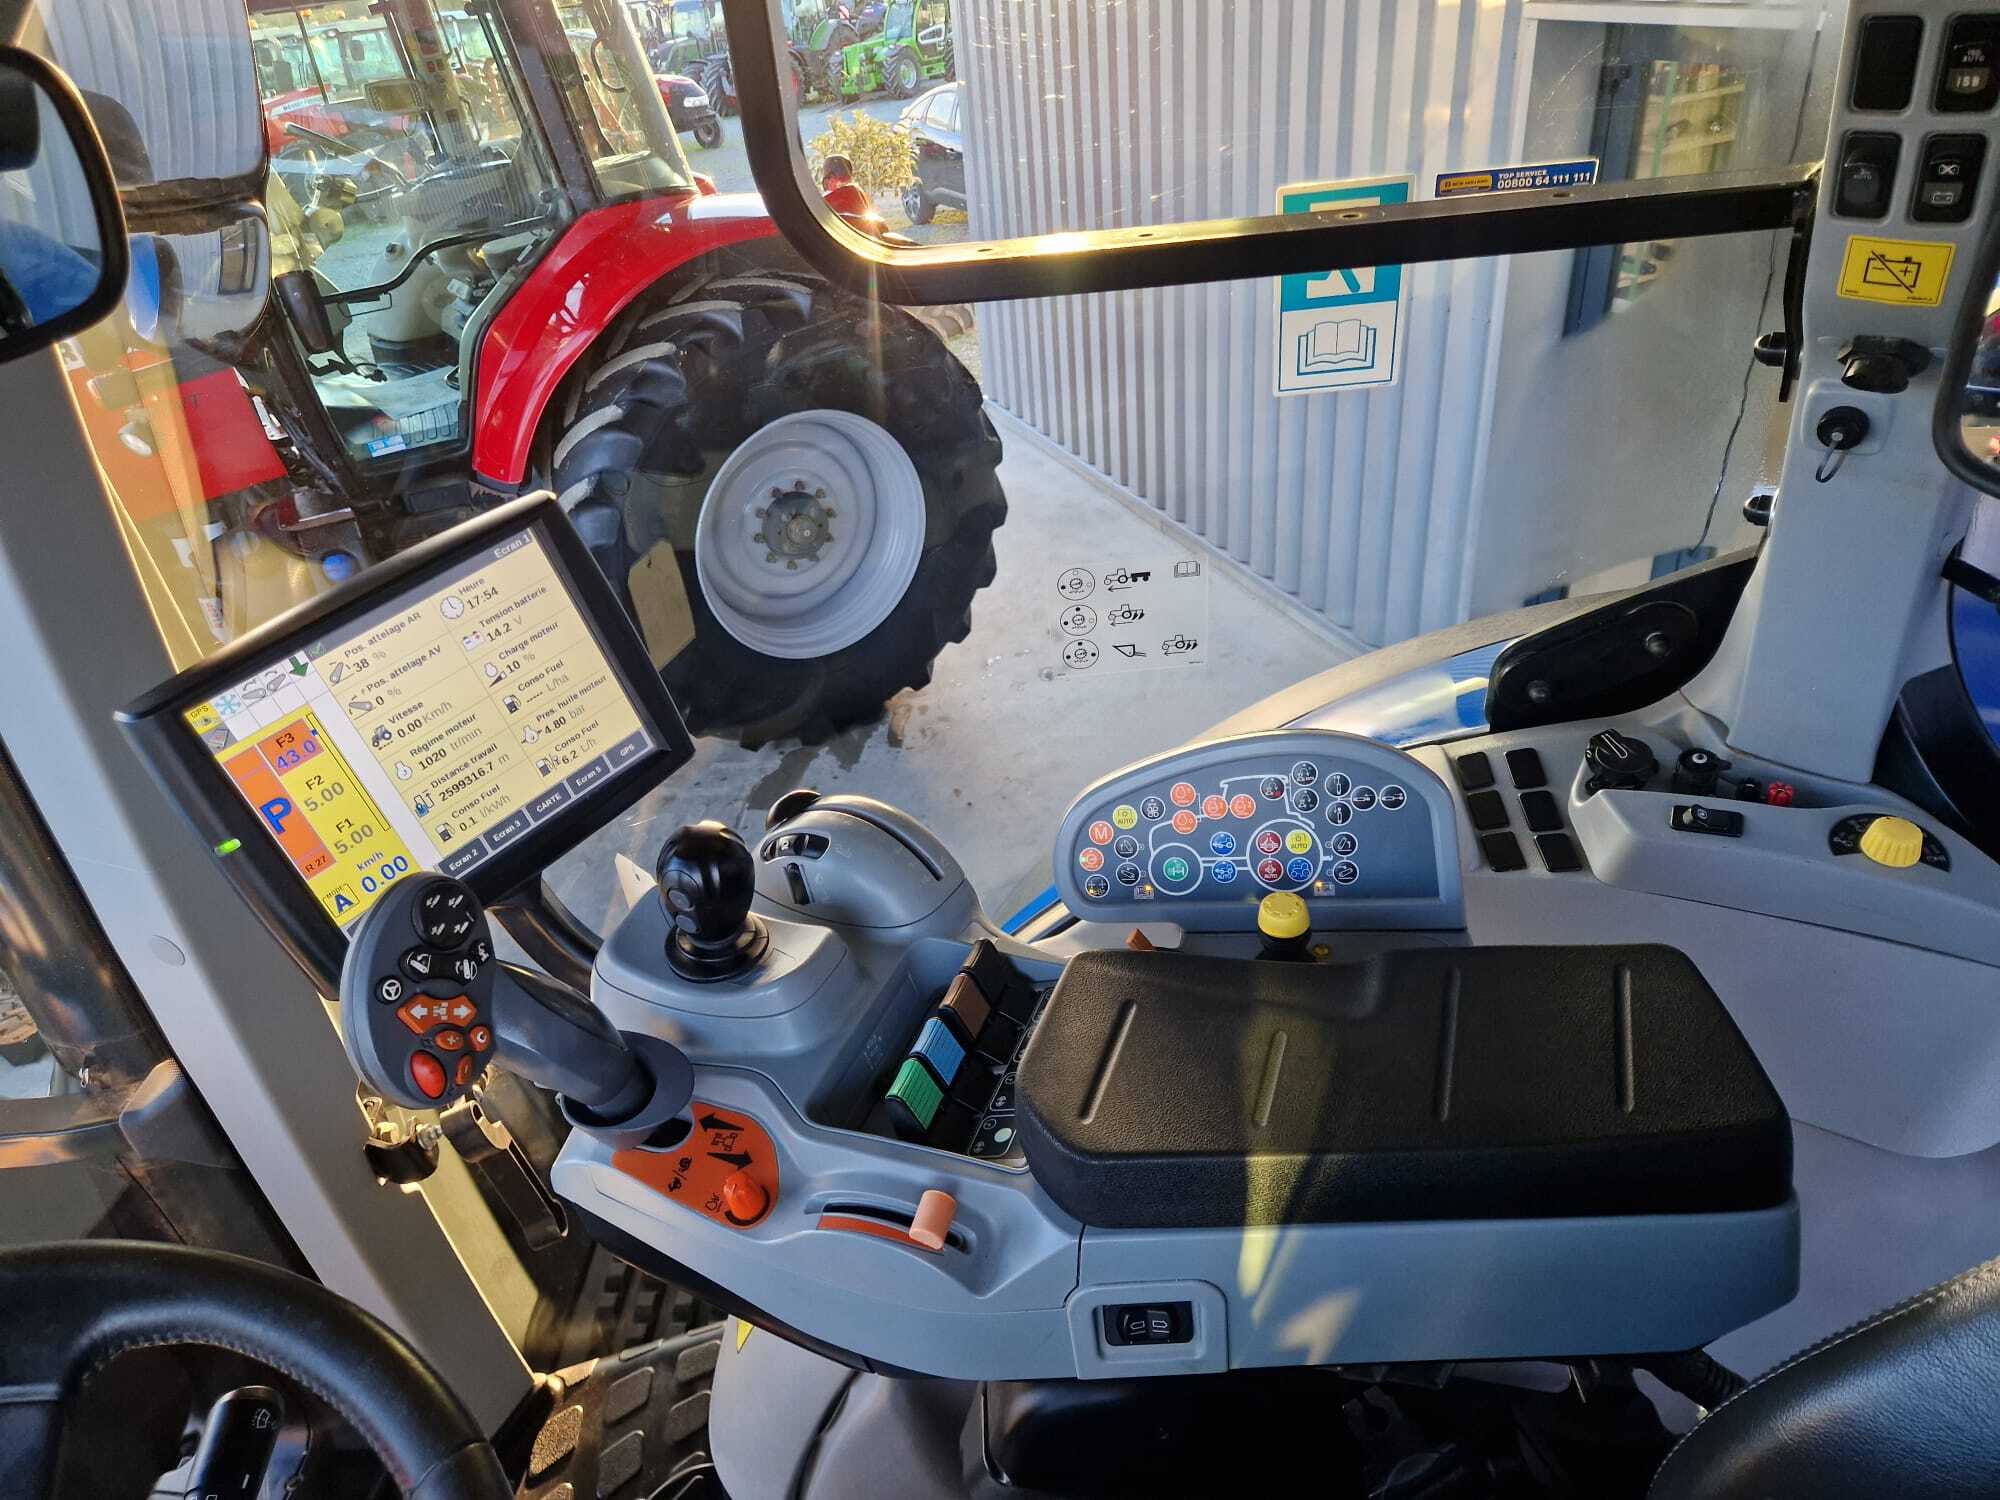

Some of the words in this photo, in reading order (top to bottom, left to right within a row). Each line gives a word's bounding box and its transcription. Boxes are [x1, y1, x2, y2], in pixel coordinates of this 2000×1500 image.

[1497, 177, 1533, 189] 00800
[1535, 176, 1549, 186] 64
[1552, 173, 1569, 184] 111
[1572, 172, 1590, 183] 111
[1499, 171, 1515, 179] TOP
[1516, 169, 1547, 178] SERVICE
[494, 539, 522, 558] Ecran
[523, 534, 531, 546] 1
[458, 577, 485, 595] Heure
[467, 587, 498, 610] 17:54
[479, 605, 514, 628] Tension
[514, 586, 547, 609] batterie
[344, 641, 365, 658] Pos.
[368, 621, 407, 647] attelage
[407, 612, 422, 624] AR
[487, 623, 512, 643] 14.2
[515, 616, 524, 626] V
[499, 640, 529, 660] Charge
[529, 622, 559, 644] moteur
[353, 658, 370, 673] 38
[366, 677, 387, 692] Pos.
[389, 653, 428, 678] attelage
[428, 645, 441, 656] AV
[508, 660, 521, 674] 10
[517, 671, 545, 693] Conso
[544, 659, 565, 677] Fuel
[375, 696, 385, 706] 0
[536, 707, 555, 723] Pres.
[557, 692, 578, 710] huile
[578, 674, 608, 696] moteur
[190, 704, 210, 719] GPS
[388, 701, 424, 725] Vitesse
[544, 716, 567, 735] 4.80
[568, 704, 586, 720] bar
[276, 732, 296, 748] F3
[396, 719, 423, 739] 0.00
[409, 733, 445, 757] Régime
[444, 713, 477, 737] moteur
[554, 732, 581, 753] Conso
[579, 720, 600, 738] Fuel
[276, 739, 316, 770] 43.0
[418, 749, 448, 771] 1020
[450, 728, 483, 752] tr/min
[430, 761, 469, 789] Distance
[470, 744, 498, 766] travail
[438, 763, 494, 802] 2599316.7
[498, 754, 510, 766] m
[305, 775, 325, 791] F2
[304, 782, 344, 812] 5.00
[451, 800, 479, 820] Conso
[479, 784, 501, 802] Fuel
[260, 796, 292, 835] P
[335, 817, 356, 834] F1
[459, 817, 478, 832] 0.1
[334, 824, 374, 854] 5.00
[492, 827, 514, 842] Ecran
[514, 818, 522, 829] 3
[1094, 826, 1108, 838] M
[356, 850, 384, 872] km/h
[449, 854, 471, 871] Ecran
[470, 848, 478, 858] 2
[361, 855, 409, 894] 0.00
[334, 894, 354, 913] A
